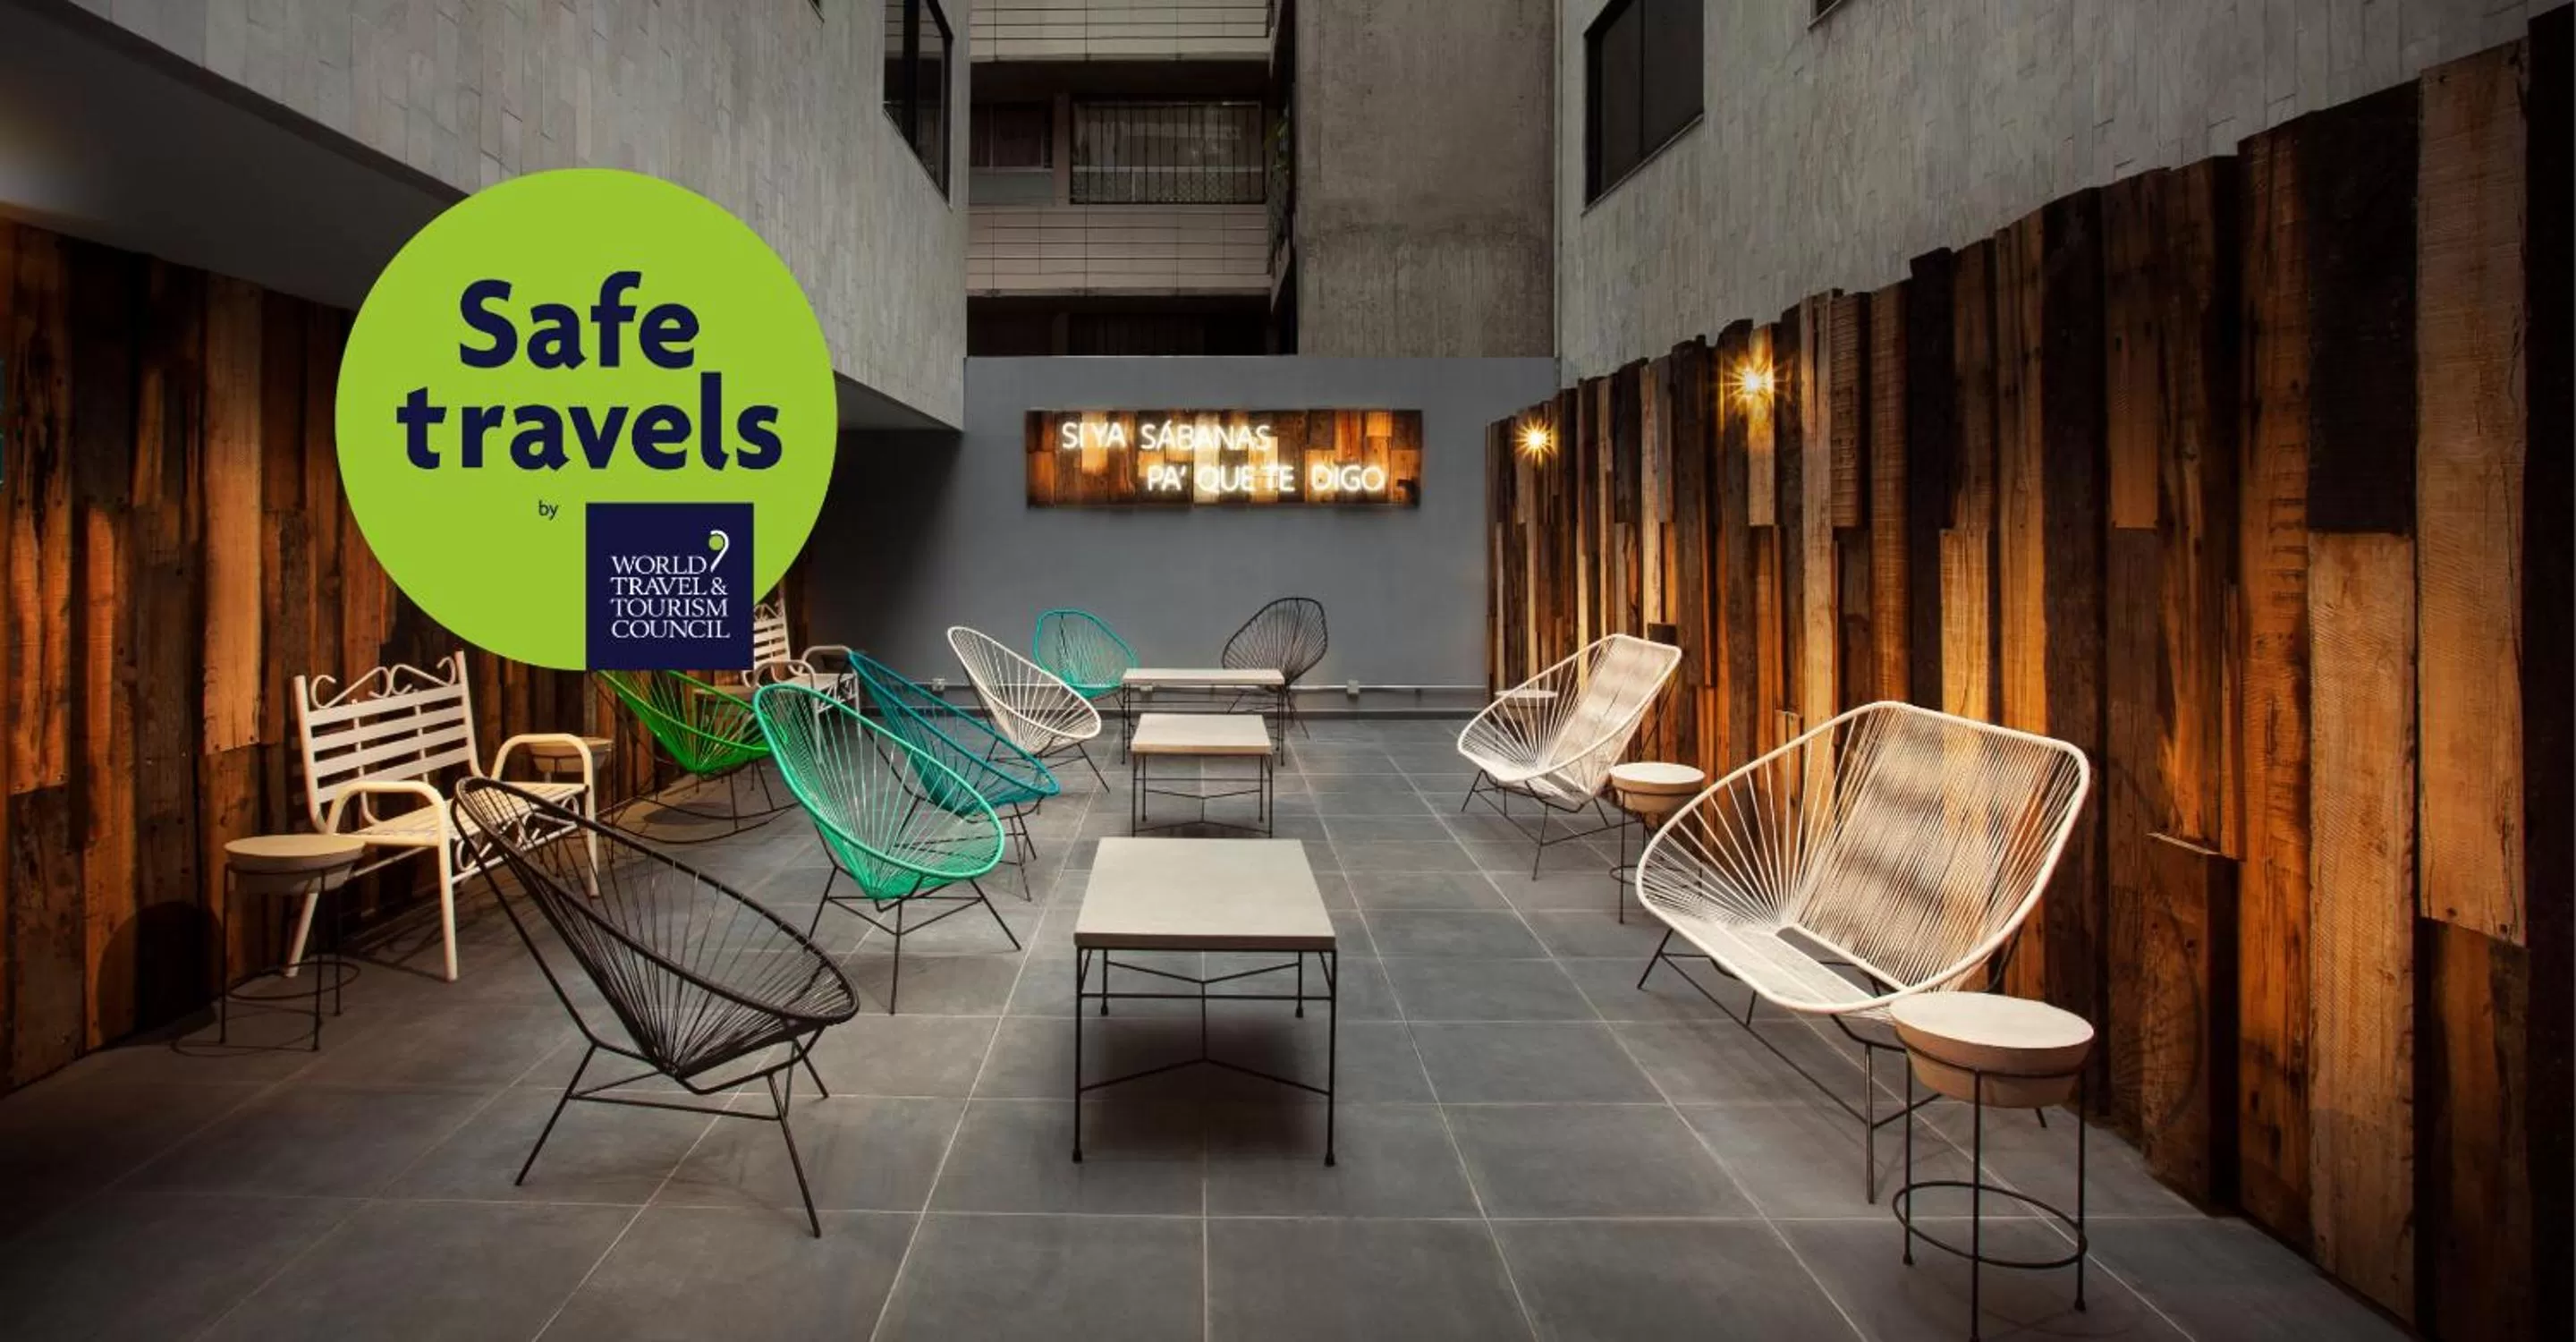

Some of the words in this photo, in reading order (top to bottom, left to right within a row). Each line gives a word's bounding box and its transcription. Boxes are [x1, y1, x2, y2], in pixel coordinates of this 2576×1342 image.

[1061, 421, 1085, 449] SI
[1091, 421, 1127, 449] YA
[1140, 420, 1271, 451] SÁBANAS
[1198, 464, 1254, 493] QUE
[1259, 464, 1295, 492] TE
[1310, 464, 1385, 492] DIGO
